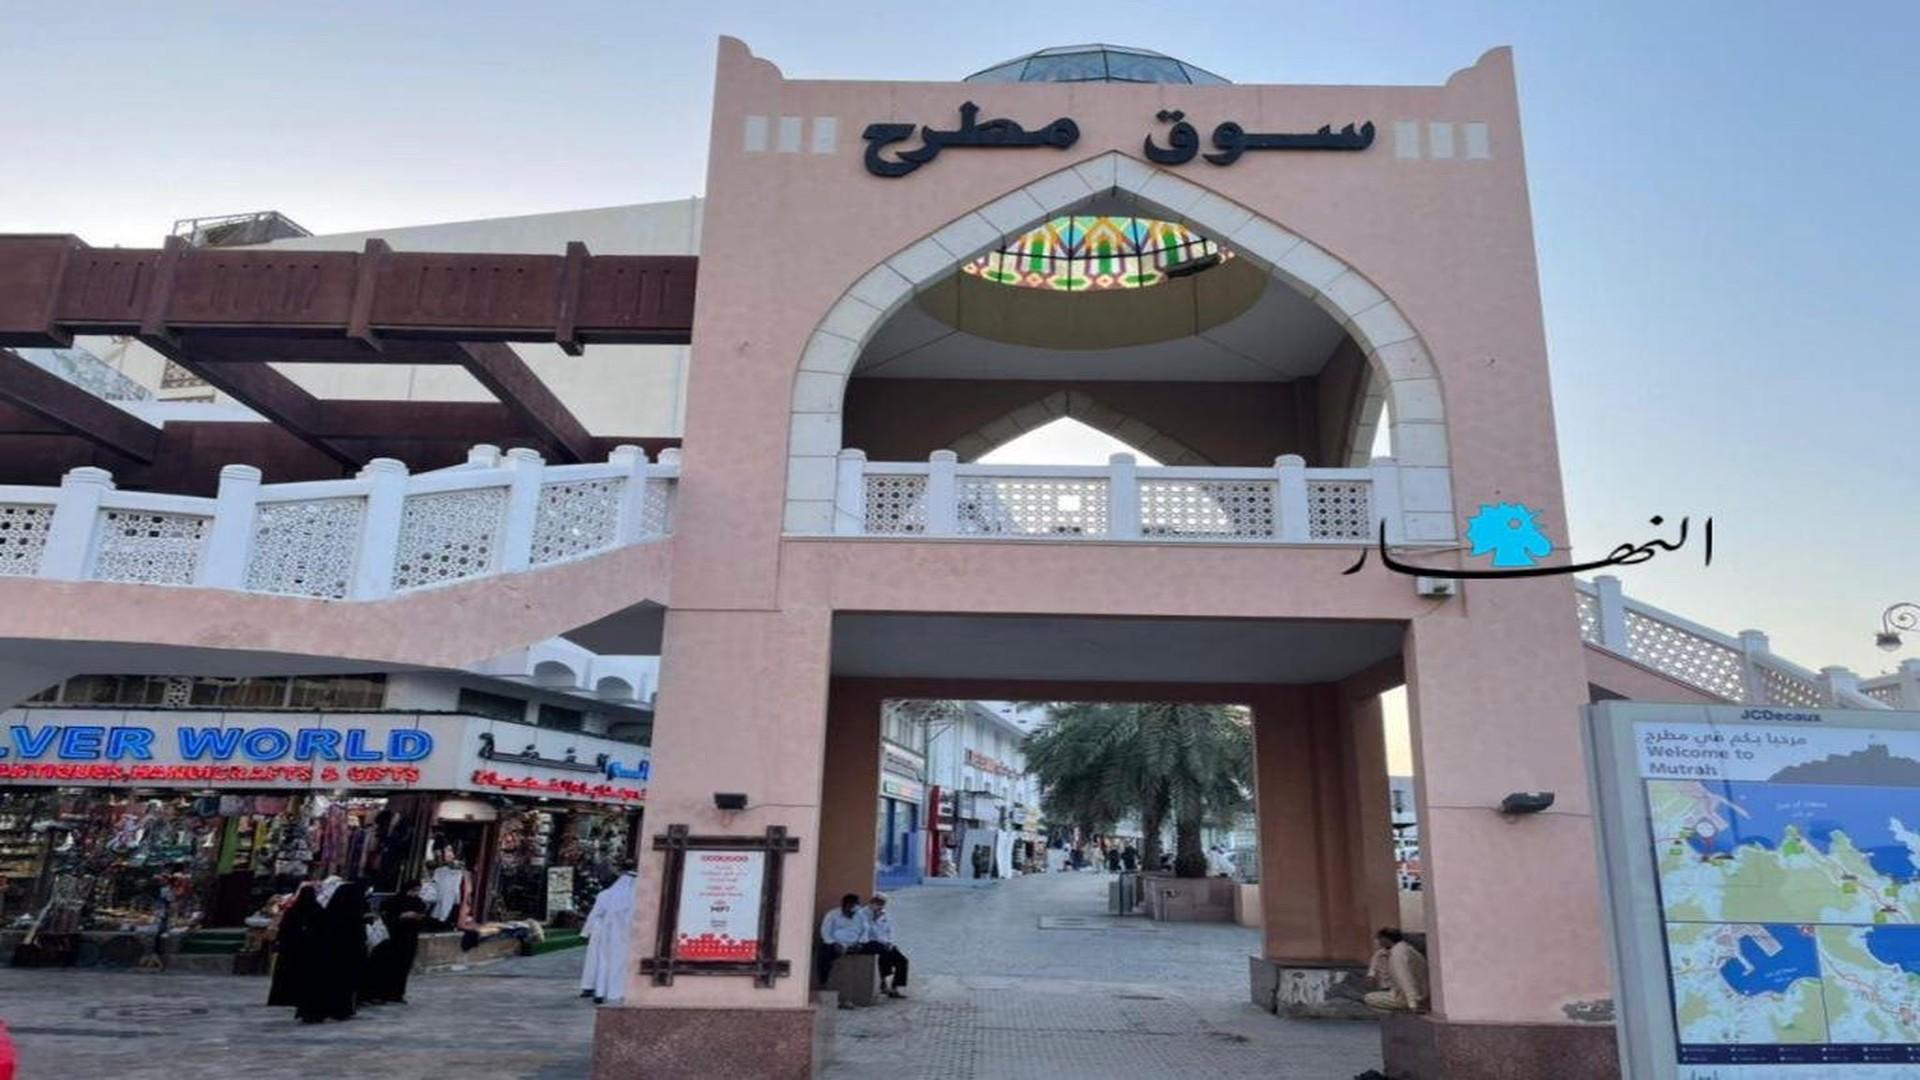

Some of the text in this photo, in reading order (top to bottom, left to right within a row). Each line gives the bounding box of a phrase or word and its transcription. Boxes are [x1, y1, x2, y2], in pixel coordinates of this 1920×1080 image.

[862, 101, 1375, 178] سوق مطرح
[1740, 709, 1822, 722] JCDecaux
[0, 725, 434, 761] VER WORLD
[1645, 730, 1808, 748] مرحبا بكم في مطرح
[1647, 746, 1755, 760] Welcome to
[320, 766, 340, 782] &
[347, 766, 420, 783] GIFTS
[1649, 762, 1718, 776] Mutrah
